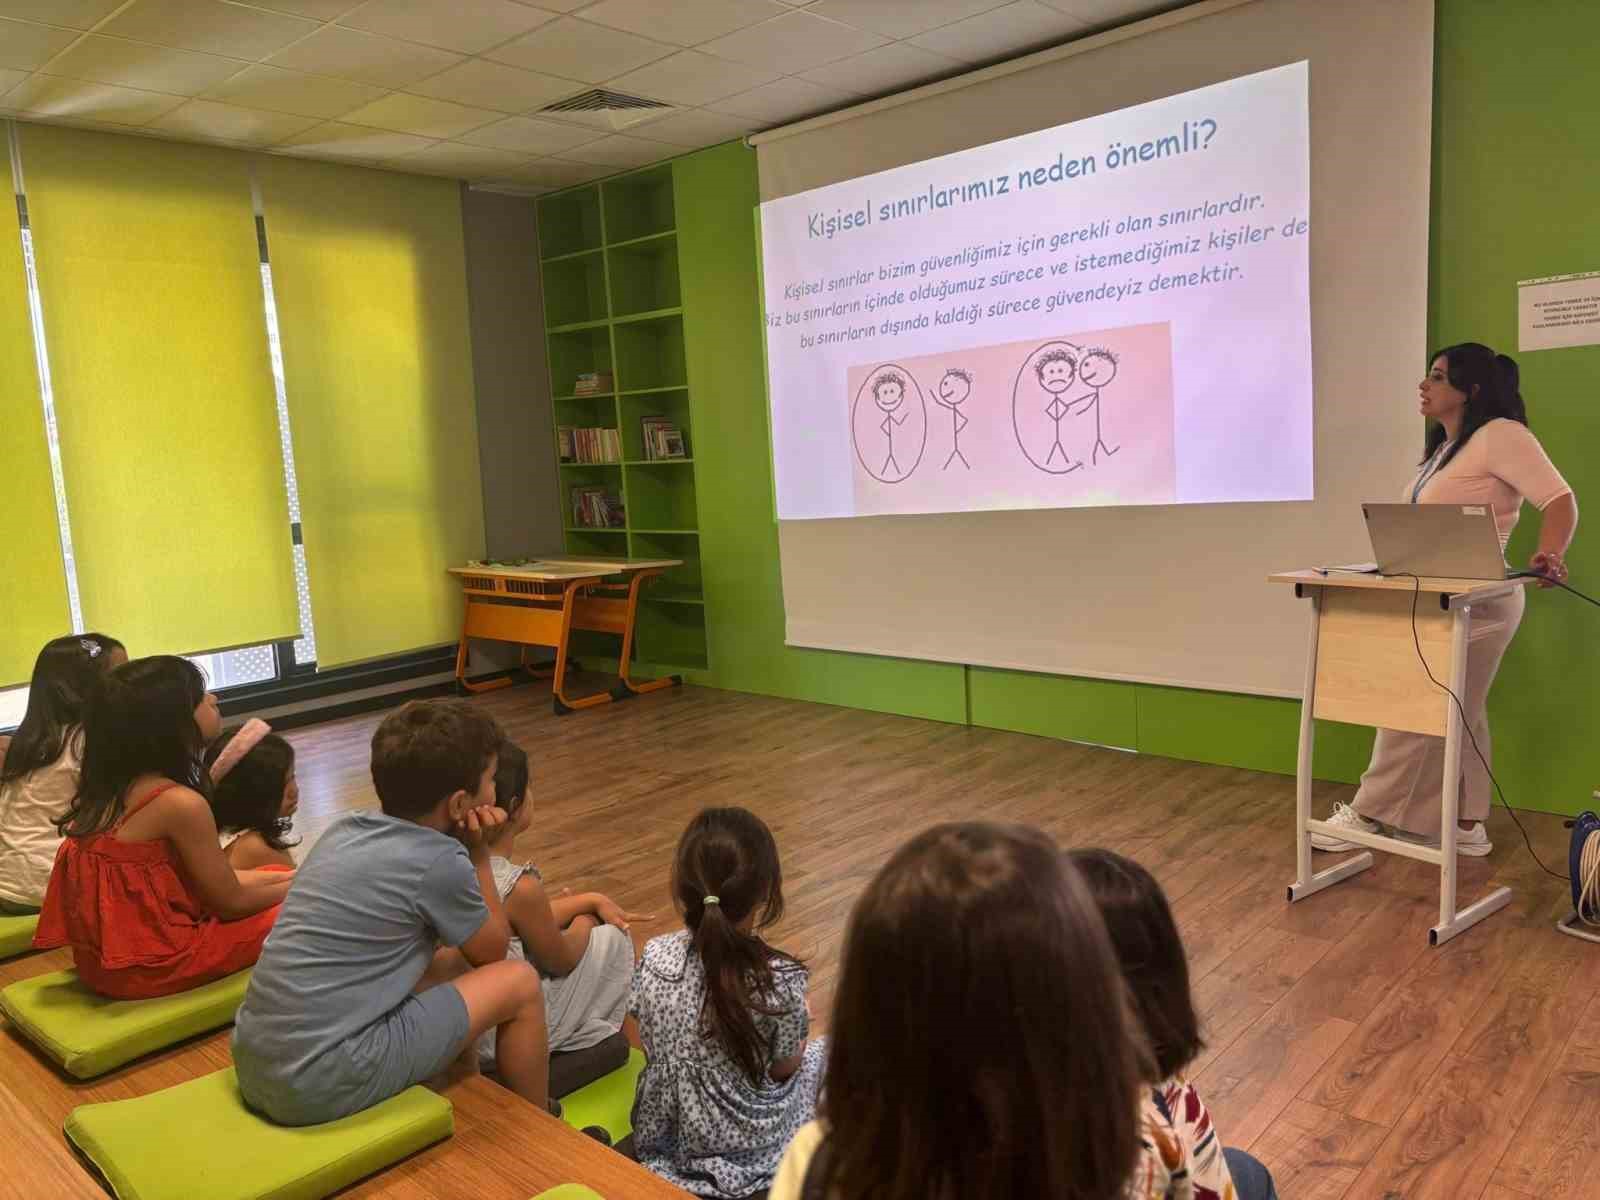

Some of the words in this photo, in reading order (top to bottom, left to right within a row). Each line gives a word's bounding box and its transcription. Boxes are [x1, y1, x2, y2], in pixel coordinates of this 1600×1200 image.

[807, 199, 872, 239] Kişisel
[879, 175, 1009, 221] sınırlarımız
[1018, 152, 1096, 189] neden
[1105, 118, 1217, 169] önemli?
[784, 279, 824, 300] Kişisel
[828, 270, 874, 292] sınırlar
[879, 263, 915, 281] bizim
[920, 242, 1012, 277] güvenliğimiz
[1017, 234, 1045, 256] için
[1050, 219, 1111, 252] gerekli
[1115, 216, 1152, 235] olan
[1158, 193, 1265, 227] sınırlardır.
[785, 311, 800, 325] bu
[803, 300, 860, 320] sınırların
[864, 290, 905, 311] içinde
[909, 277, 985, 301] olduğumuz
[990, 268, 1044, 287] sürece
[1050, 261, 1068, 276] ve
[1075, 236, 1200, 272] istemediğimiz
[1208, 225, 1275, 250] kişiler
[1281, 217, 1308, 238] de
[800, 334, 814, 349] bu
[817, 326, 876, 345] sınırların
[880, 314, 929, 336] dışında
[934, 304, 983, 325] kaldığı
[987, 297, 1041, 317] sürece
[1046, 278, 1143, 312] güvendeyiz
[1149, 262, 1243, 292] demektir.
